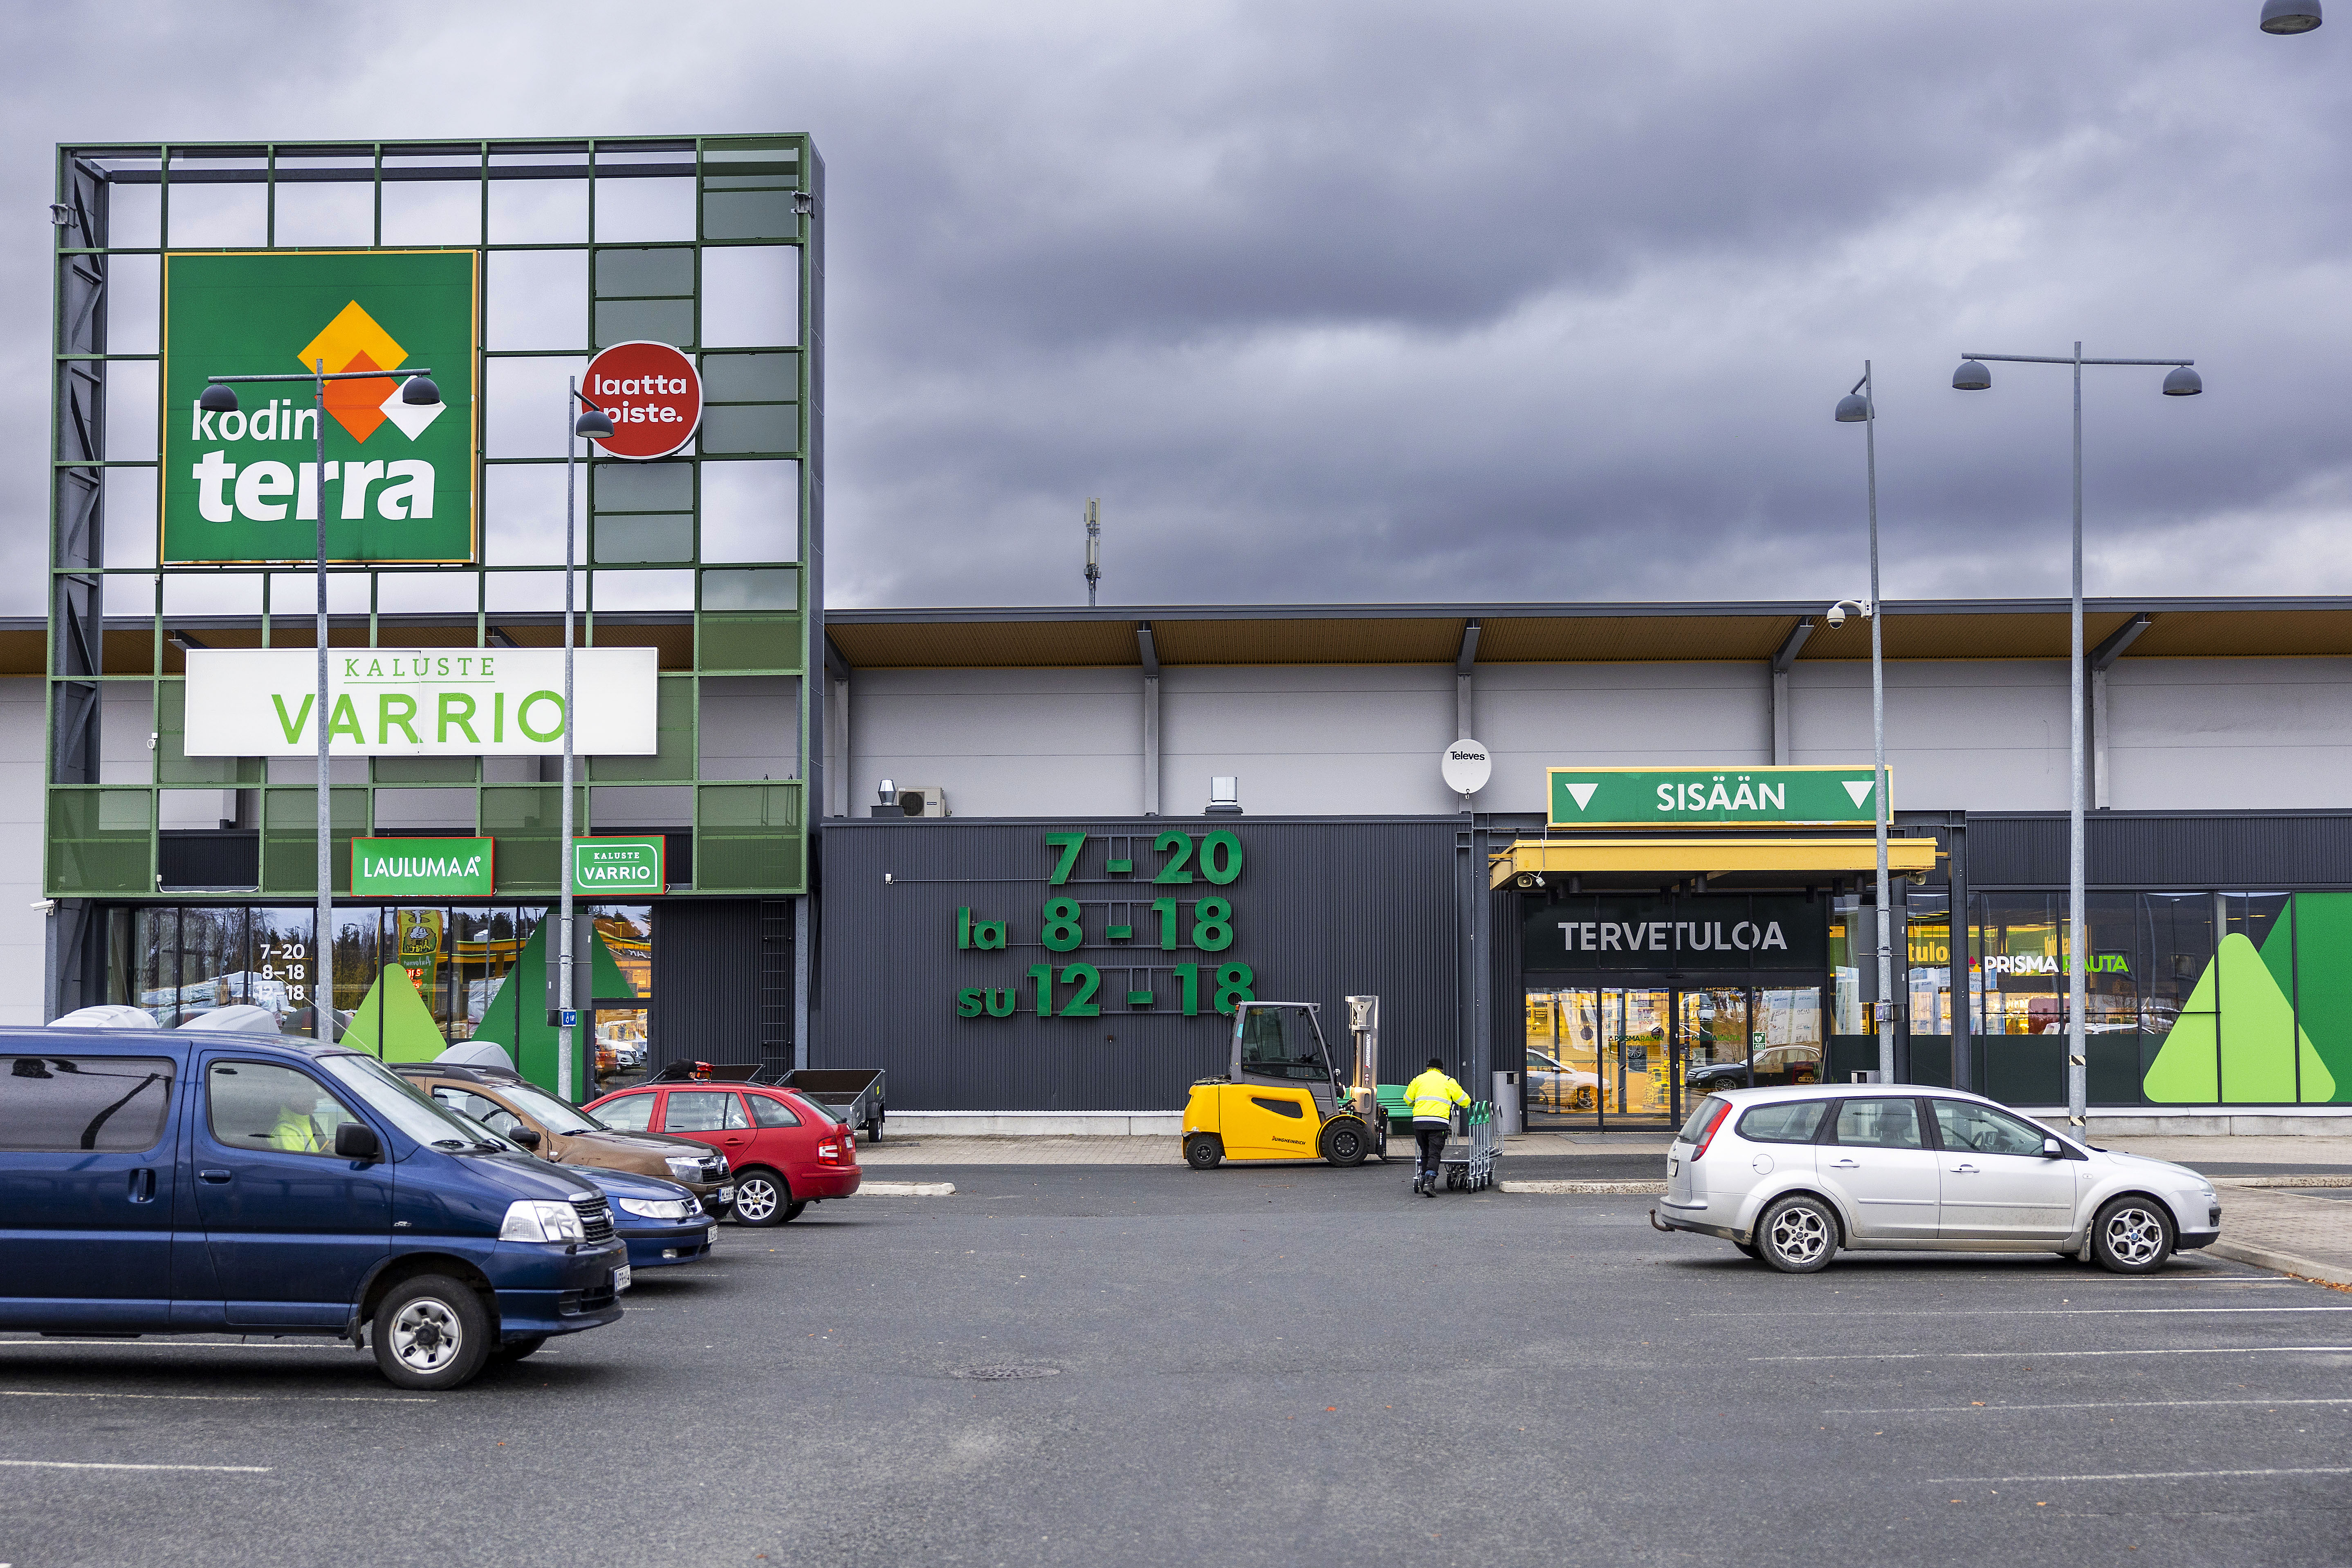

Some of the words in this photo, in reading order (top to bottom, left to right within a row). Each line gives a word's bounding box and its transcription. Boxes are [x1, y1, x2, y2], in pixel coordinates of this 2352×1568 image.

[595, 374, 687, 395] laatta
[192, 399, 318, 441] kodin
[193, 449, 435, 523] terra
[344, 657, 495, 677] KALUSTE
[271, 690, 566, 745] VARRIO
[1450, 751, 1485, 760] Televes
[1657, 776, 1785, 811] SISÄÄN
[584, 866, 650, 879] VARRIO
[1045, 832, 1087, 884] 7
[1152, 830, 1242, 885] 20
[958, 906, 1006, 950] la
[1041, 897, 1082, 951] 8
[1151, 896, 1233, 951] 18
[1558, 921, 1788, 951] TERVETULOA
[1984, 955, 2060, 973] PRISMA
[957, 987, 1016, 1017] su
[1027, 962, 1100, 1016] 12
[1173, 961, 1255, 1016] 18
[1272, 1135, 1306, 1145] JUNGHEINRICH
